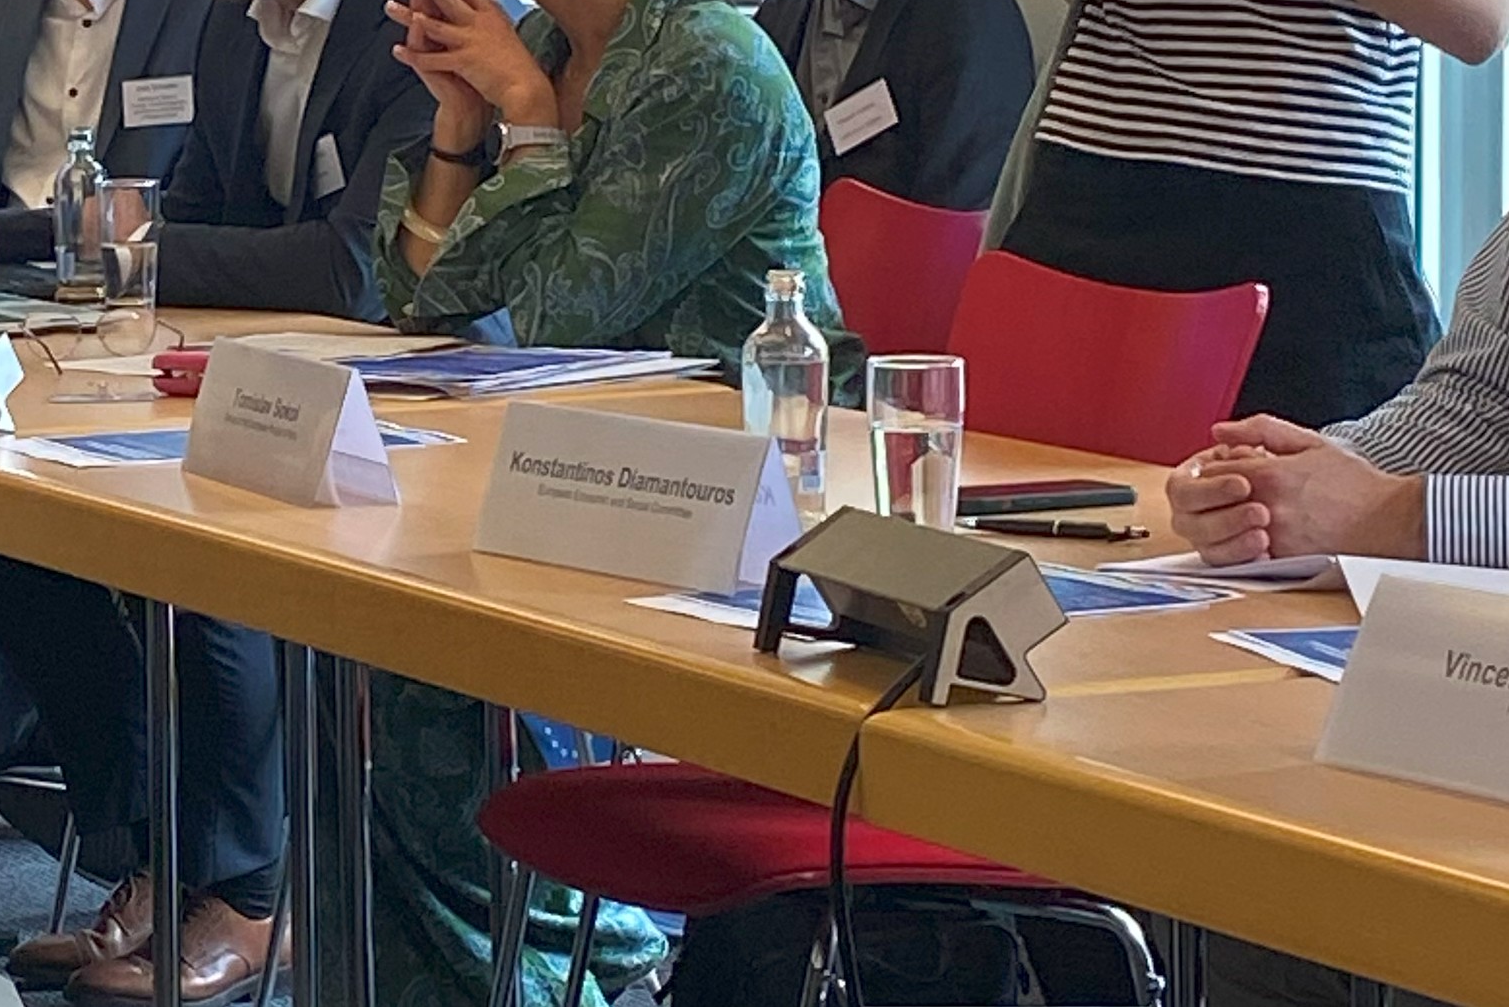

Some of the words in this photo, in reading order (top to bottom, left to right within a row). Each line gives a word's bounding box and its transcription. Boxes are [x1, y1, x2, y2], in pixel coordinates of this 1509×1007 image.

[509, 449, 615, 487] Konstantinos
[617, 466, 736, 506] Diamantouros
[1445, 648, 1509, 689] Vince
